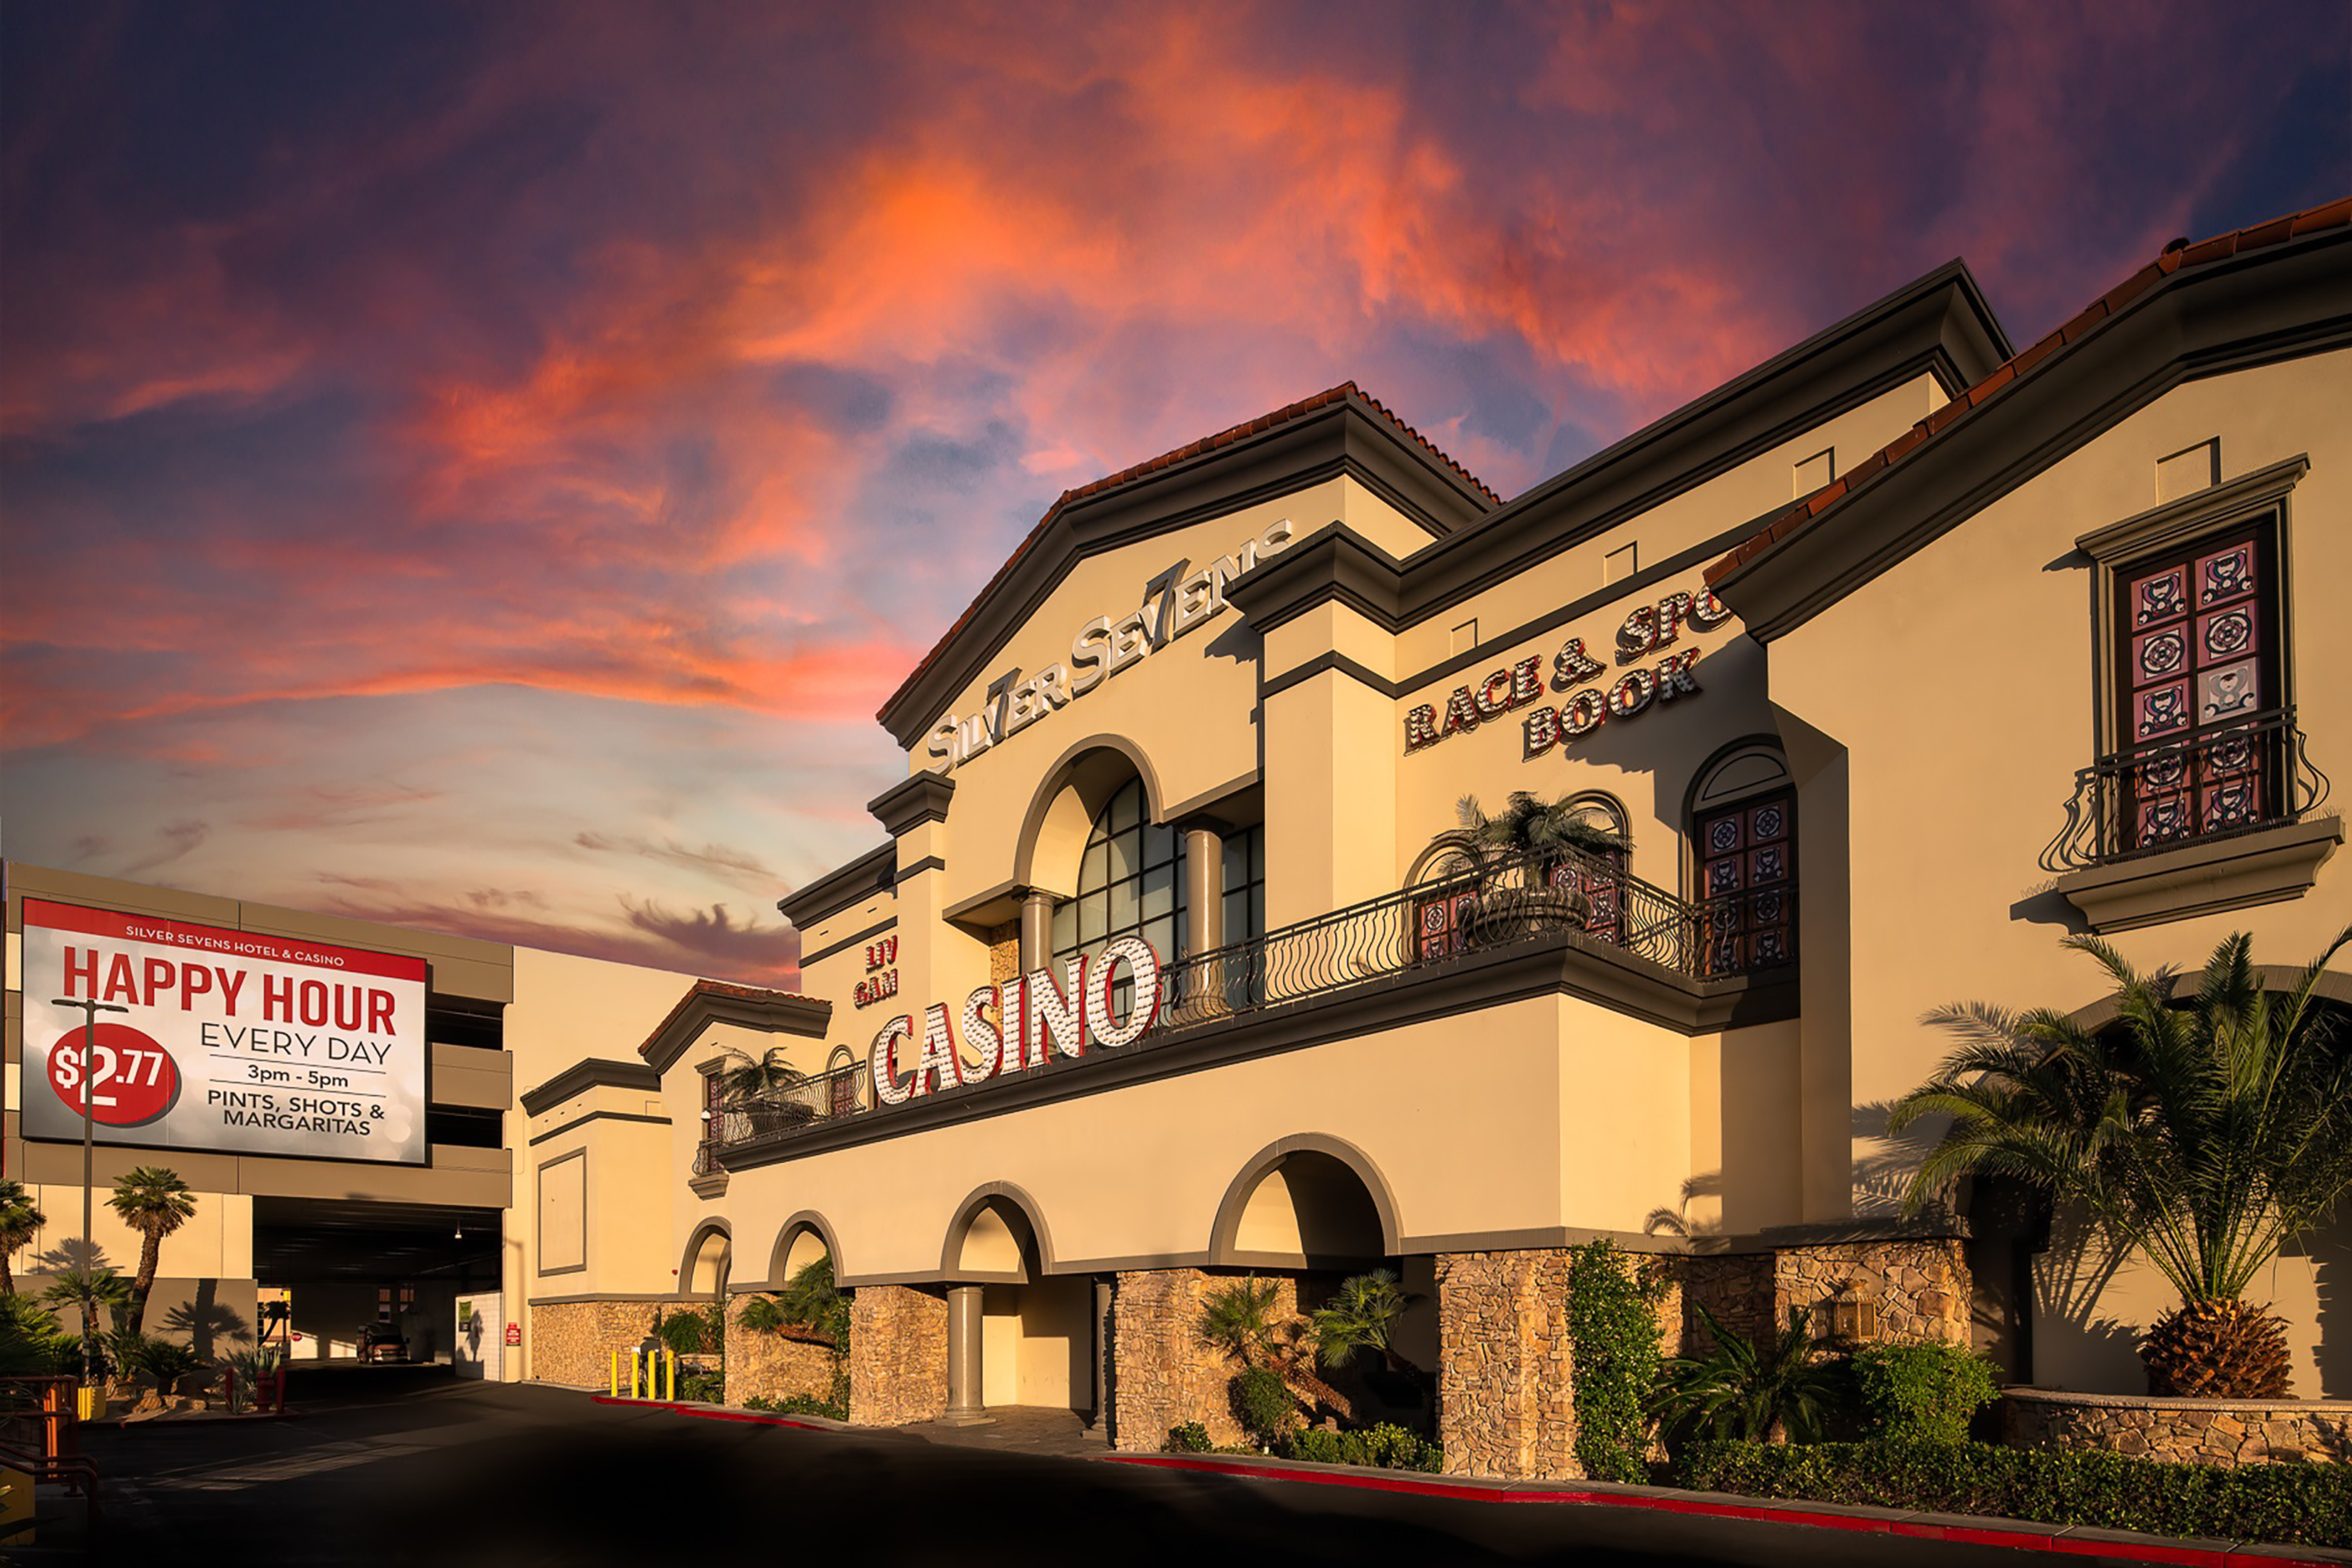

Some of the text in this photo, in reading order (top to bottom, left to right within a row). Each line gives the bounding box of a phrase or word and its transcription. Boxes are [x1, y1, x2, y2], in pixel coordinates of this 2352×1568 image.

[1405, 655, 1545, 750] RACE
[1556, 637, 1607, 685] &
[1527, 646, 1703, 755] BOOK
[125, 925, 344, 967] SILVER SEVENS HOTEL & CASINO
[63, 946, 396, 1036] HAPPY HOUR
[201, 1022, 391, 1065] EVERY DAY
[872, 935, 1162, 1105] CASINO
[55, 1045, 164, 1107] $2.77
[247, 1064, 290, 1083] 3pm
[308, 1071, 349, 1088] 5pm
[208, 1089, 385, 1120] PINTS, SHOTS &
[224, 1110, 371, 1136] MARGARITAS
